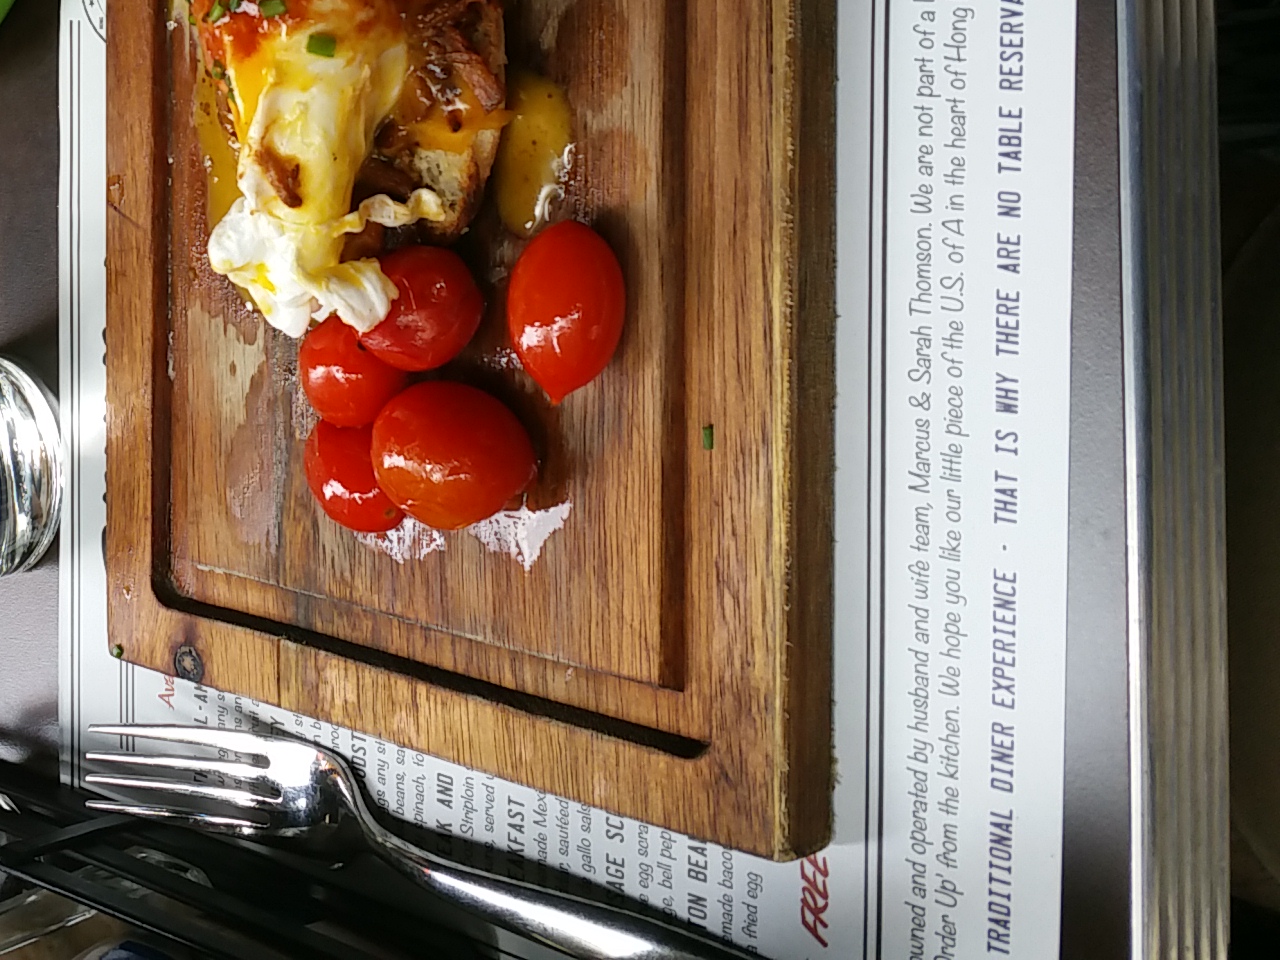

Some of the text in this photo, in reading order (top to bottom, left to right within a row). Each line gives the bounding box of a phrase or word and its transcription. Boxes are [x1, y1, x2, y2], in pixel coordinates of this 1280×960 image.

[920, 11, 937, 22] a
[942, 7, 975, 62] Hong
[912, 24, 936, 49] of
[913, 57, 942, 97] part
[943, 64, 968, 90] of
[913, 105, 934, 136] not
[943, 98, 967, 149] heart
[997, 106, 1023, 174] TABLE
[917, 145, 934, 176] are
[942, 157, 966, 185] the
[909, 184, 934, 213] We
[944, 195, 965, 211] in
[996, 191, 1022, 218] NO
[940, 219, 965, 236] A
[908, 223, 933, 316] Thomson.
[941, 237, 965, 263] of
[996, 232, 1021, 274] ARE
[939, 272, 965, 312] U.S.
[941, 321, 965, 349] the
[995, 289, 1021, 356] THERE
[907, 326, 933, 384] Sarah
[940, 352, 964, 378] of
[908, 392, 932, 411] &
[943, 386, 970, 437] piece
[994, 372, 1020, 414] WHY
[907, 419, 932, 493] Marcus
[994, 429, 1019, 456] IS
[938, 443, 963, 482] little
[945, 489, 962, 522] our
[993, 470, 1019, 524] THAT
[909, 503, 934, 552] team,
[938, 530, 962, 562] like
[907, 560, 930, 599] wife
[944, 569, 968, 606] you
[907, 604, 930, 644] and
[938, 612, 969, 659] hope
[991, 568, 1017, 710] EXPERIENCE
[906, 648, 930, 733] husband
[937, 666, 961, 696] We
[906, 739, 935, 764] by
[936, 706, 961, 780] kitchen.
[990, 722, 1015, 793] DINER
[377, 759, 389, 786] any
[436, 772, 453, 810] AND
[393, 771, 406, 816] beans,
[460, 776, 478, 837] Striploin
[482, 783, 494, 833] served
[906, 767, 934, 855] operated
[936, 787, 960, 815] the
[555, 798, 569, 857] sautéed
[935, 824, 958, 868] from
[577, 838, 596, 874] gallo
[639, 863, 653, 888] egg
[656, 862, 672, 889] bell
[746, 872, 762, 899] egg
[904, 859, 927, 899] and
[986, 809, 1014, 955] TRADITIONAL
[742, 901, 757, 939] fried
